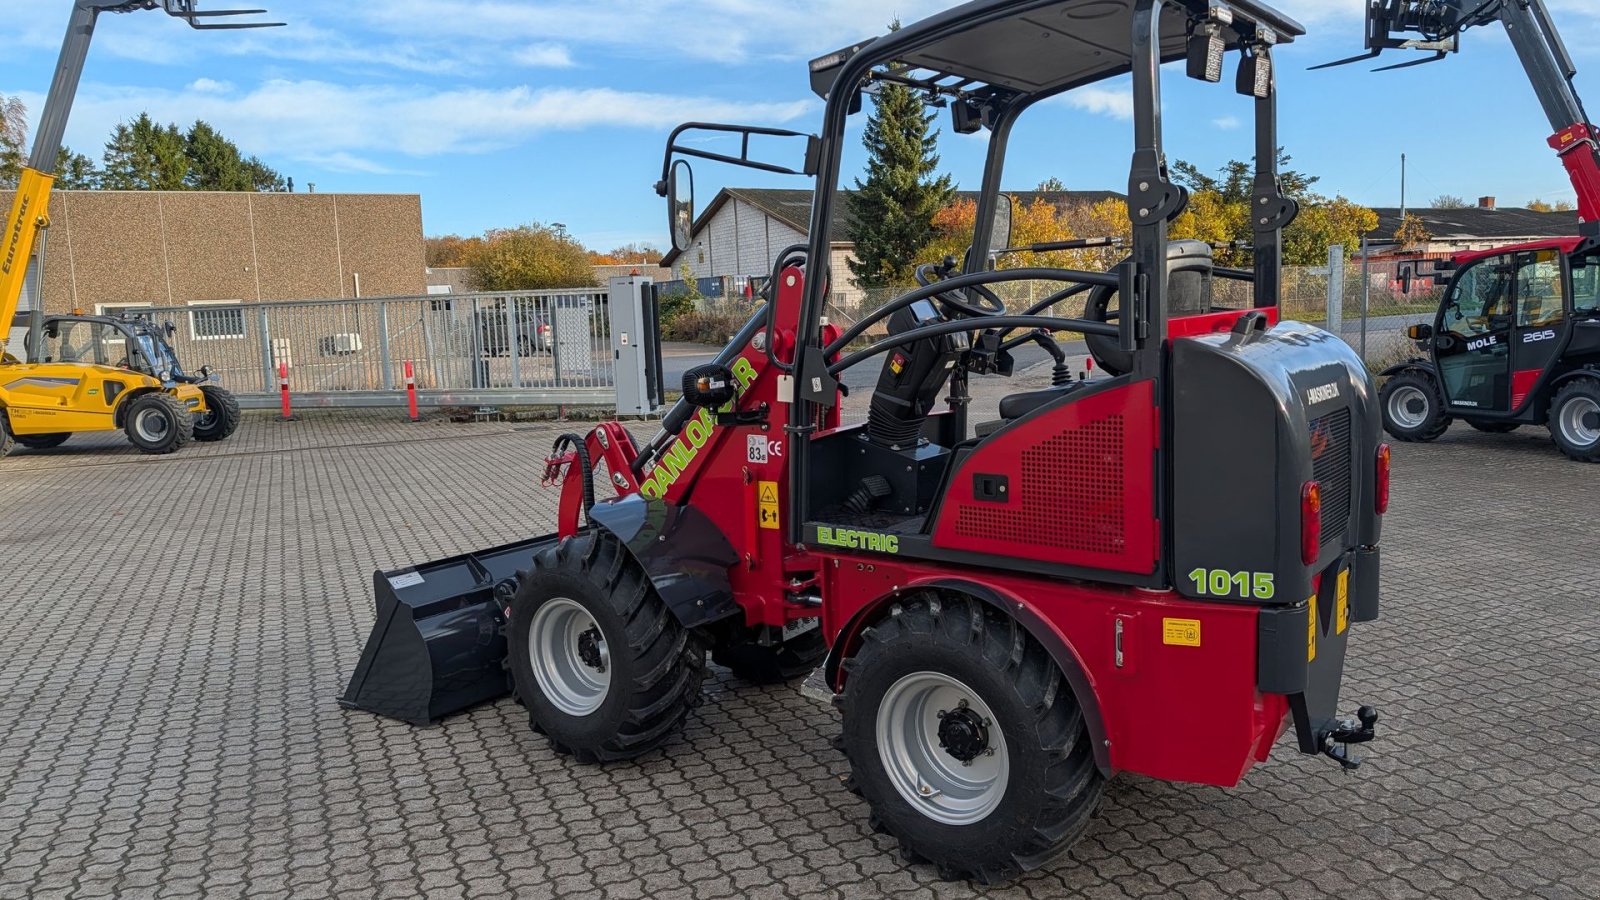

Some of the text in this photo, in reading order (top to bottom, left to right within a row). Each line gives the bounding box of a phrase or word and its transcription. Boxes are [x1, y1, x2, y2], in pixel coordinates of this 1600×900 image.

[2, 193, 30, 274] Eurotrac
[1467, 335, 1497, 351] MOLE
[1523, 329, 1556, 343] 2615
[639, 356, 759, 500] DANLOAR
[749, 446, 761, 461] 83
[817, 526, 899, 554] ELECTRIC
[1188, 567, 1275, 599] 1015
